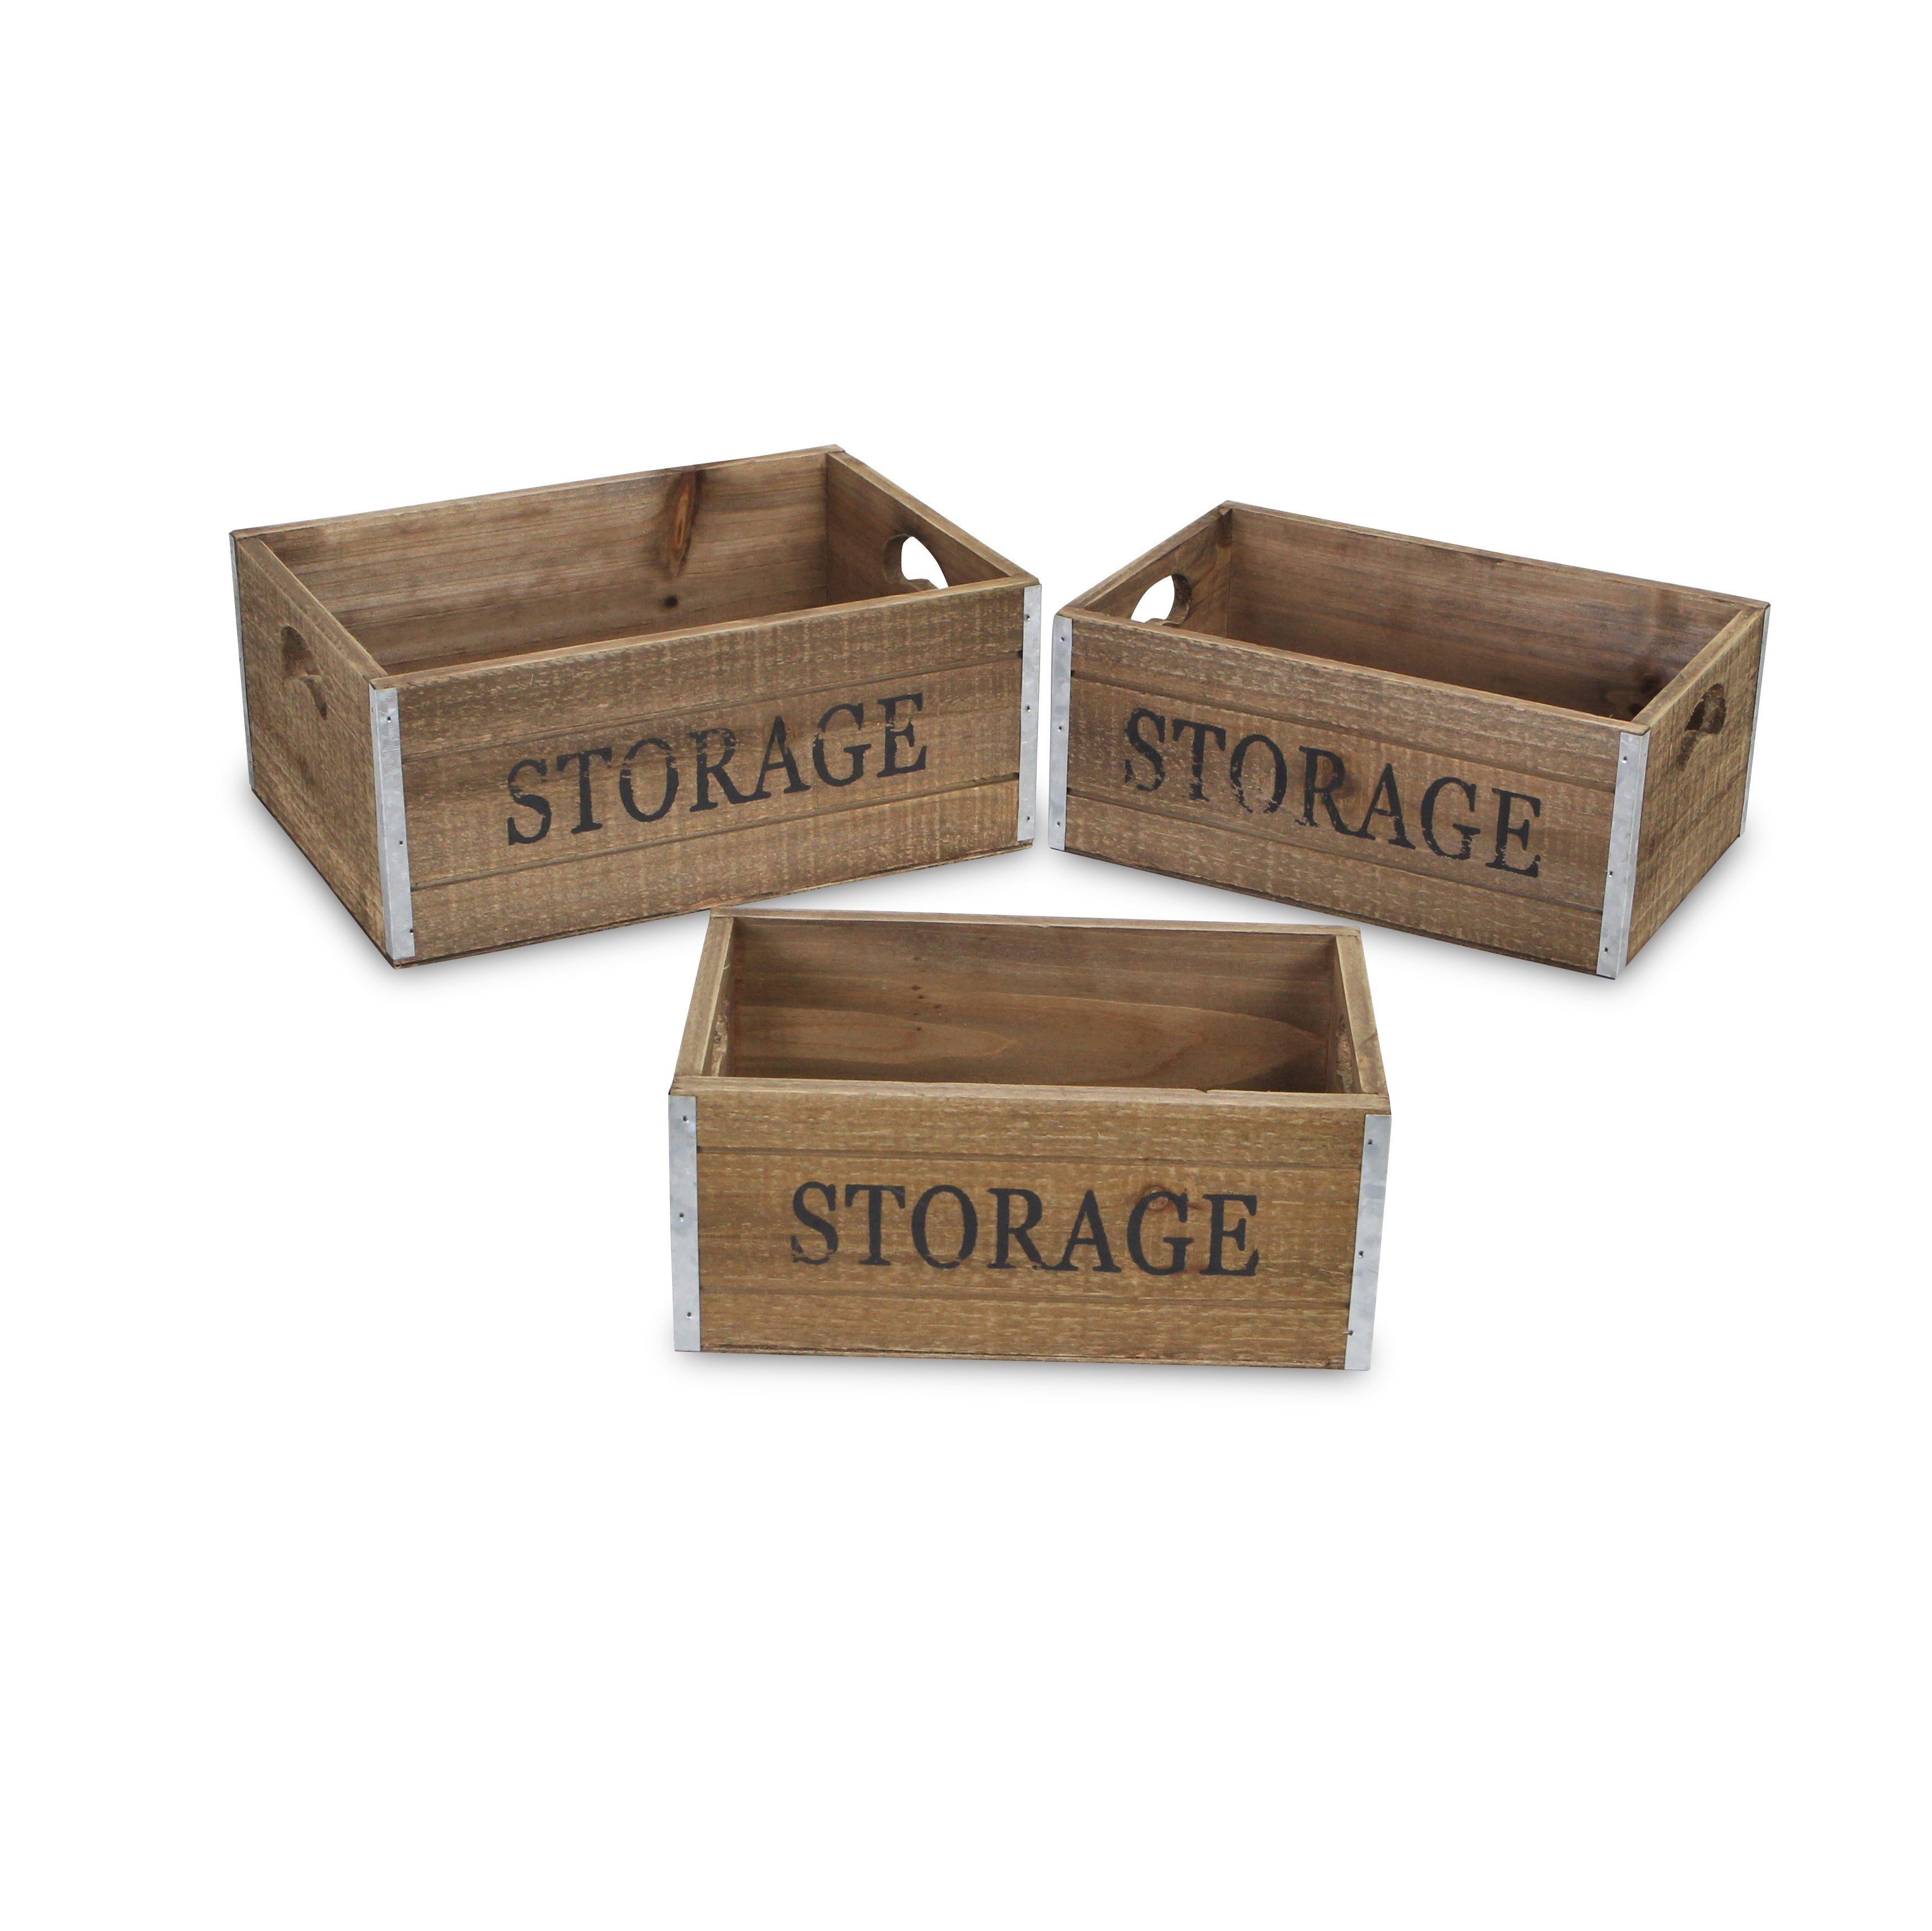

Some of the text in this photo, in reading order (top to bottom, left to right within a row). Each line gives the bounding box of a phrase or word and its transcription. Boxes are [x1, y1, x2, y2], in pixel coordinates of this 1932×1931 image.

[507, 693, 927, 845] STORAGE
[1123, 707, 1541, 878] STORAGE
[791, 1181, 1260, 1277] STORAGE
